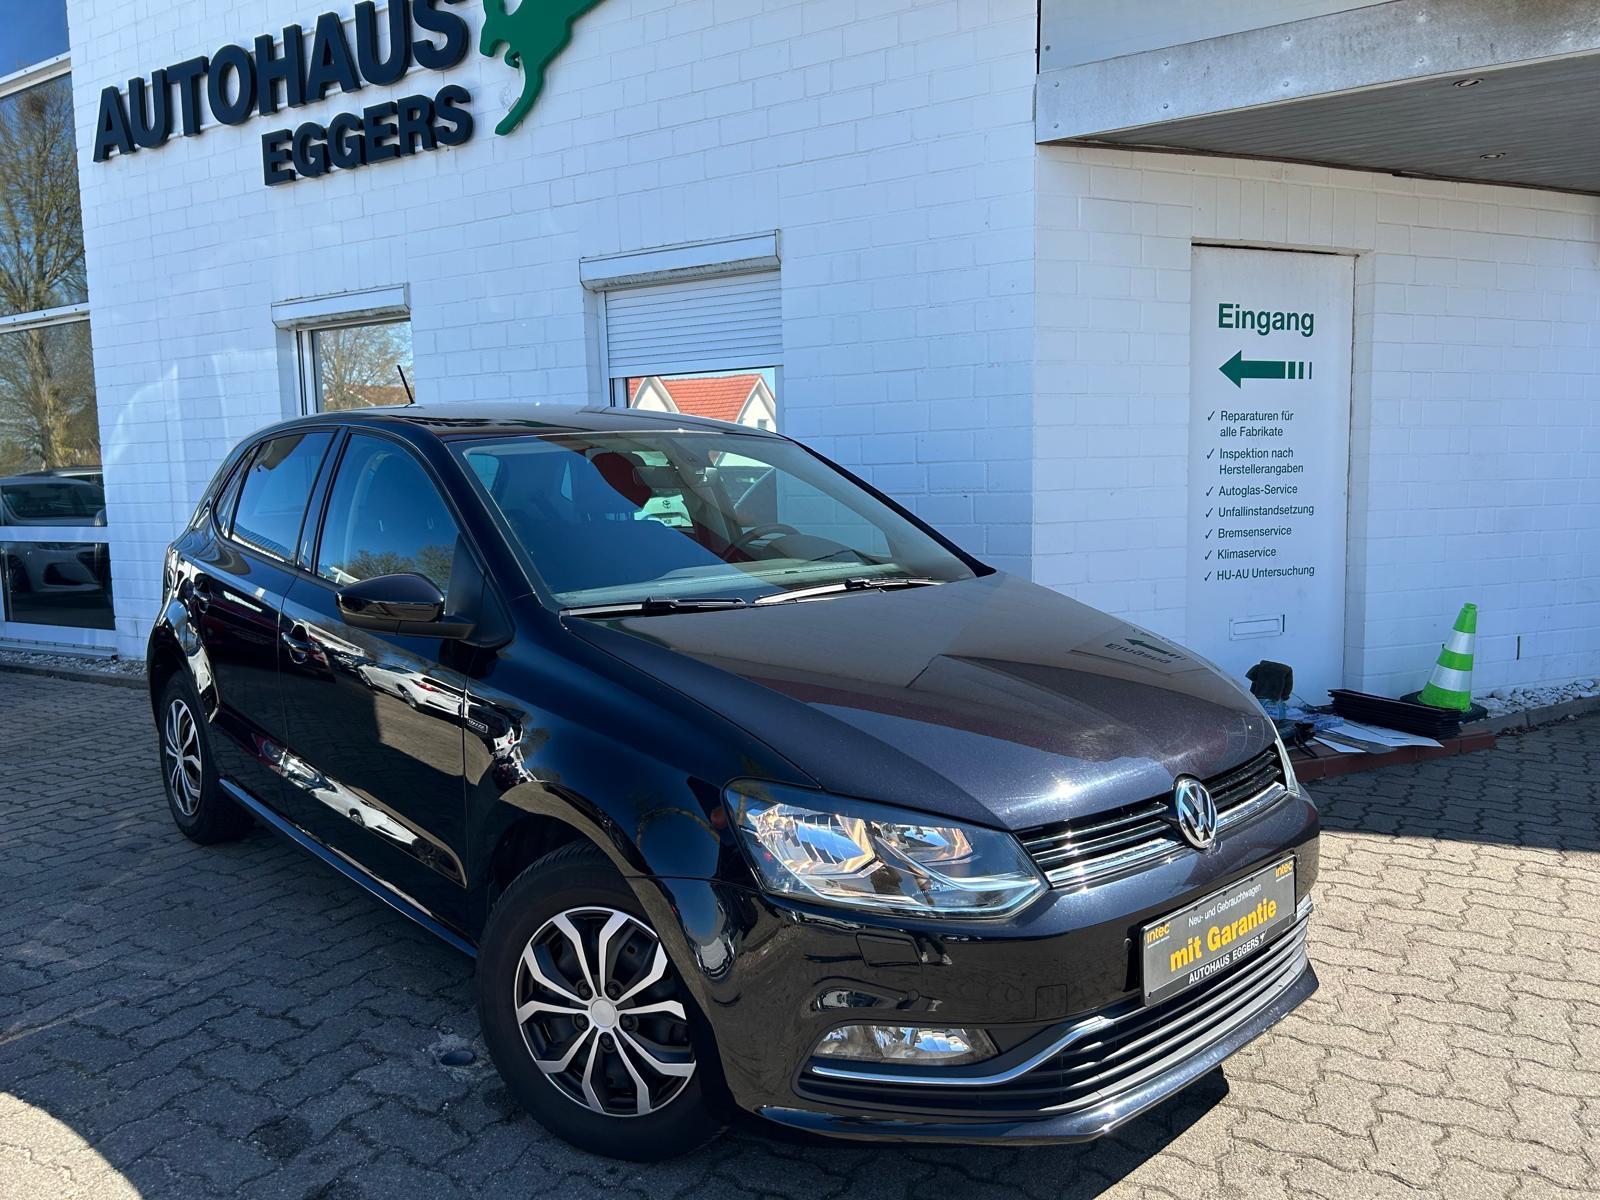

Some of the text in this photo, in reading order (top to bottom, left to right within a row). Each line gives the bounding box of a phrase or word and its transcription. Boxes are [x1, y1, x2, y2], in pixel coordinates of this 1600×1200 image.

[93, 0, 469, 162] AUTOHAUS
[262, 84, 474, 186] EGGERS
[1218, 303, 1315, 337] Eingang
[1221, 410, 1294, 423] Reparaturen für
[1220, 426, 1283, 437] alle Fabrikate
[1219, 448, 1294, 460] Inspektion nach
[1219, 463, 1304, 476] Herstellerangaben
[1218, 484, 1298, 497] Autoglas-Service
[1218, 504, 1314, 517] Unfallinstandsetzung
[1218, 526, 1292, 539] Bremsenservice
[1217, 547, 1277, 560] Klimaservice
[1217, 565, 1315, 581] HU-AU Untersuchung
[1189, 883, 1262, 927] Neu- und Gebrauchtwagen
[1147, 923, 1171, 943] intec
[1170, 898, 1277, 972] mit Garantie
[1189, 936, 1259, 984] AUTOHAUS EGGERS
